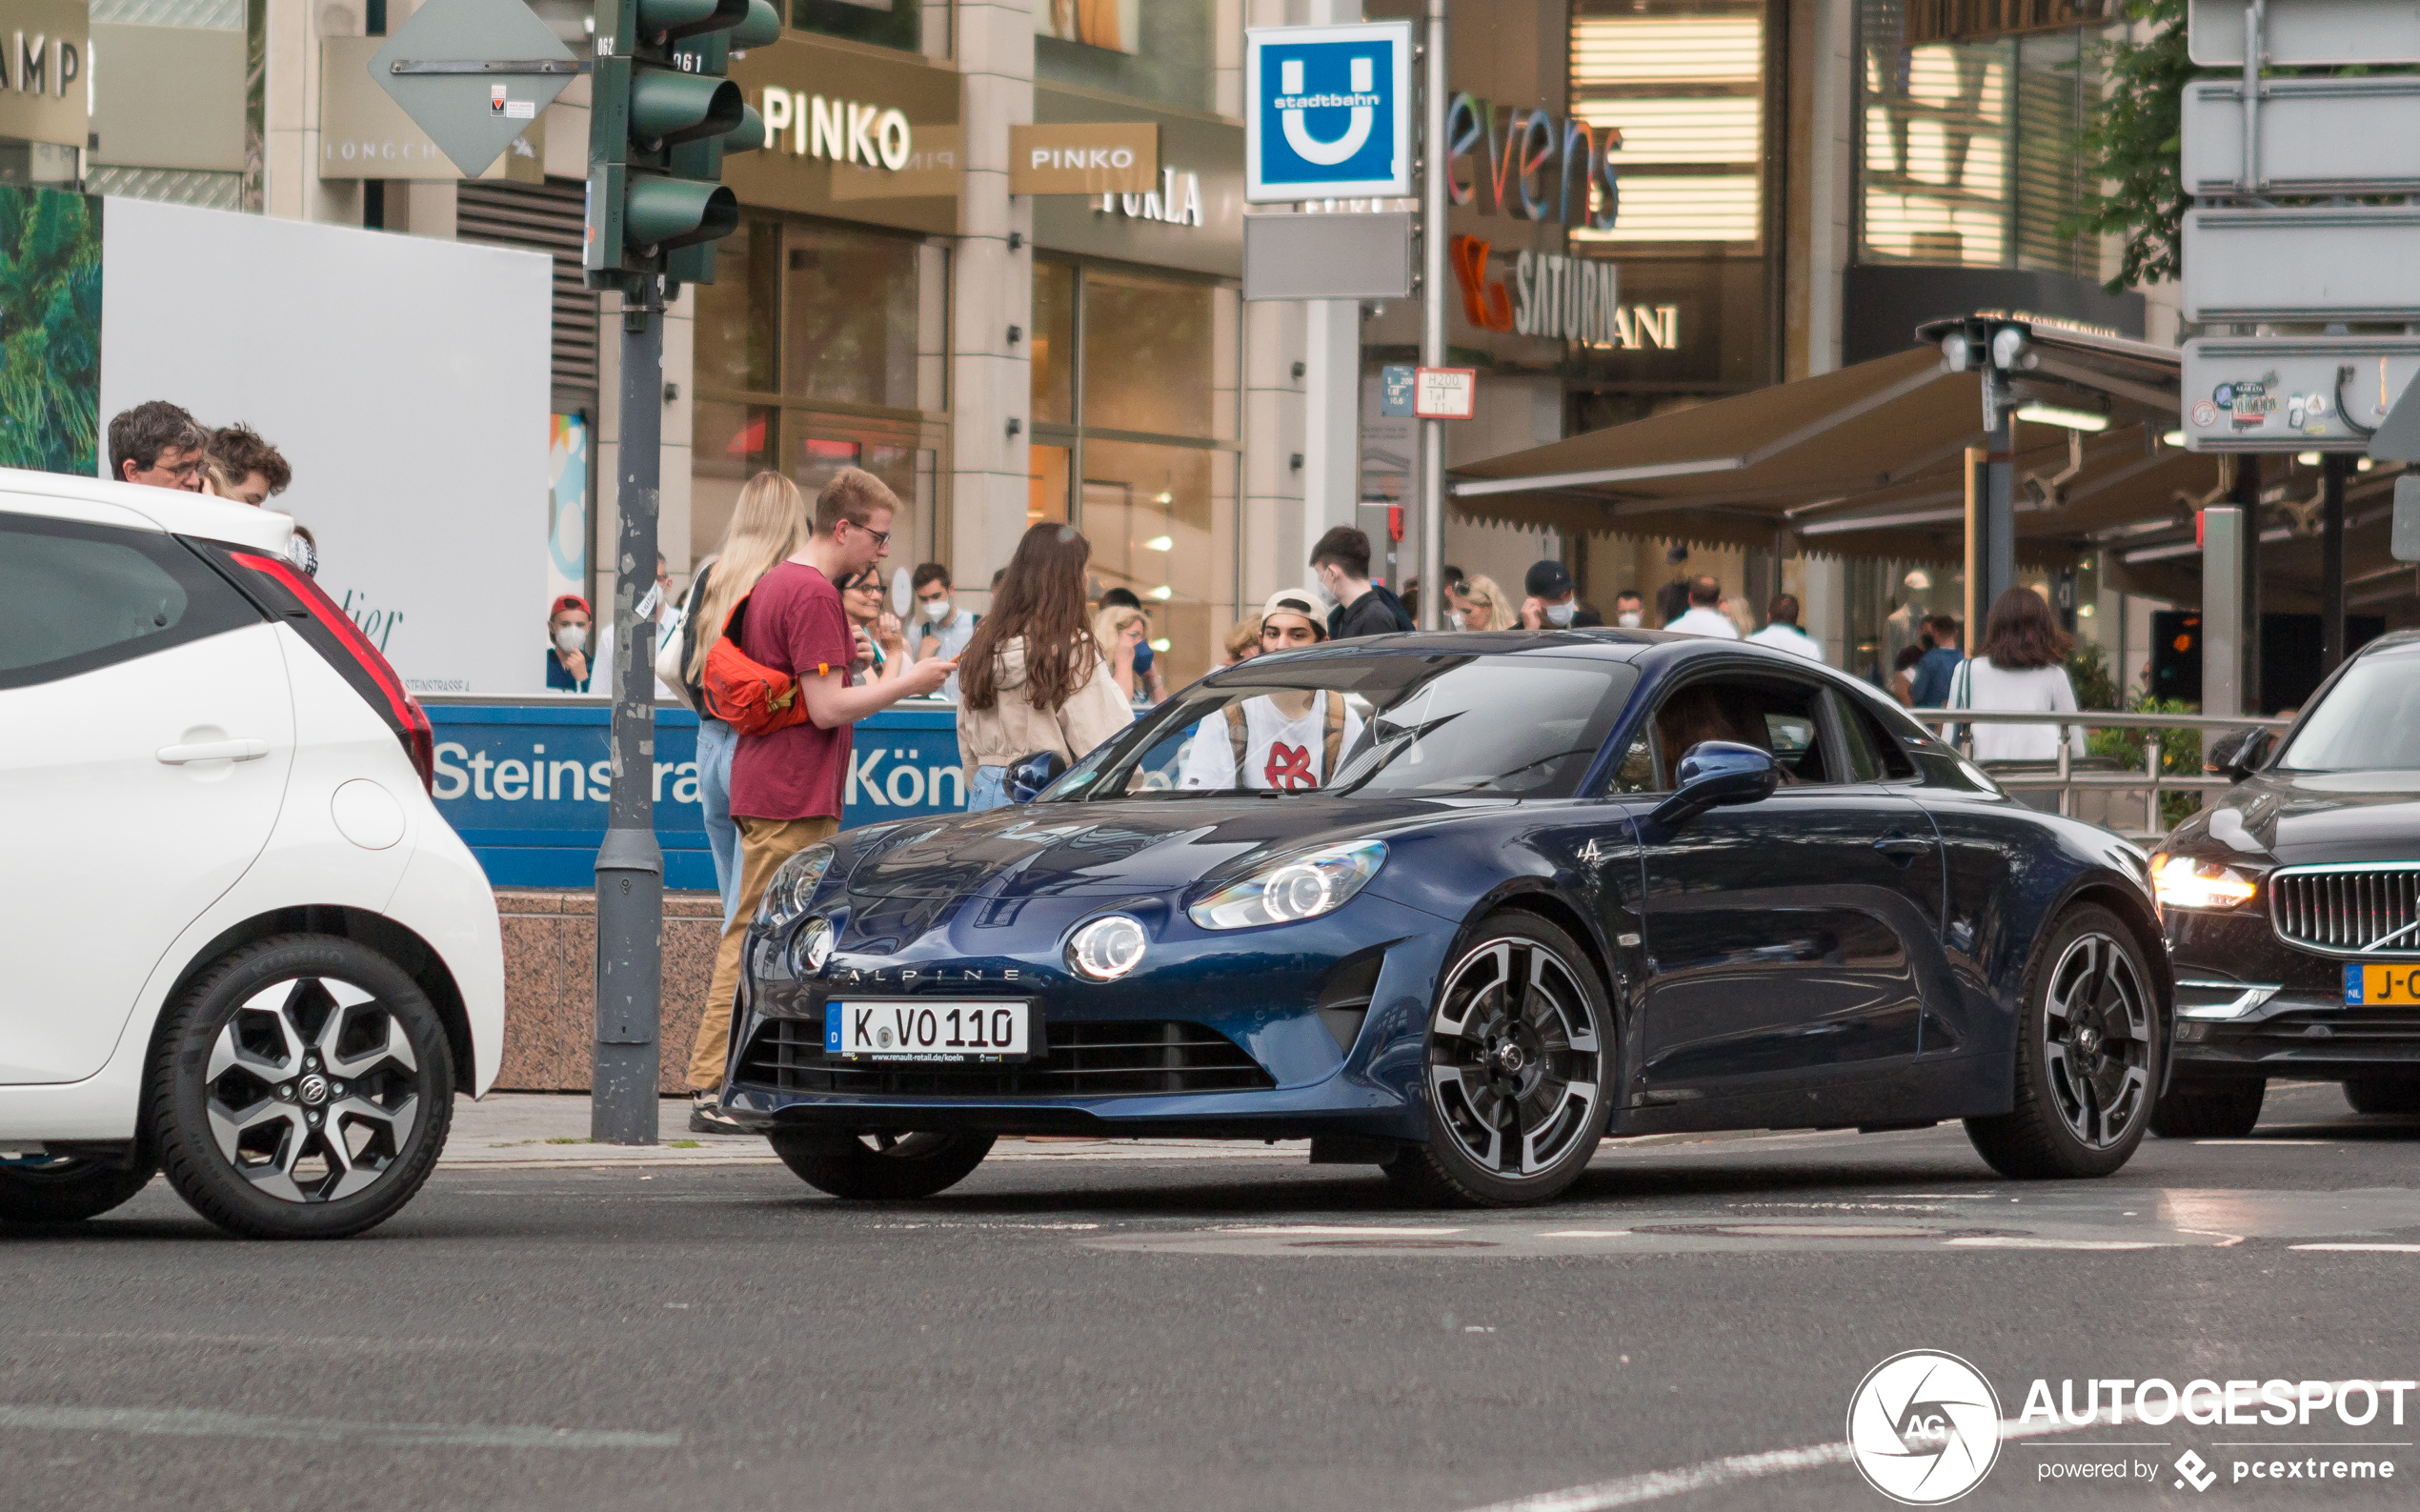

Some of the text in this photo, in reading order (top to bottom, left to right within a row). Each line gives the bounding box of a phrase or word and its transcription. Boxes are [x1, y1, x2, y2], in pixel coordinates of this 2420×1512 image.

[597, 38, 614, 56] 062
[674, 53, 701, 73] 061
[1274, 92, 1381, 110] stadtbahn
[763, 86, 912, 171] PINKO
[1032, 148, 1134, 169] PINKO
[1515, 249, 1618, 345] SATURN
[849, 969, 1019, 981] ALPINE
[2348, 989, 2362, 999] NL
[831, 1008, 1013, 1048] D K VO 110
[872, 1053, 965, 1063] www.renault-retail.de/koeln
